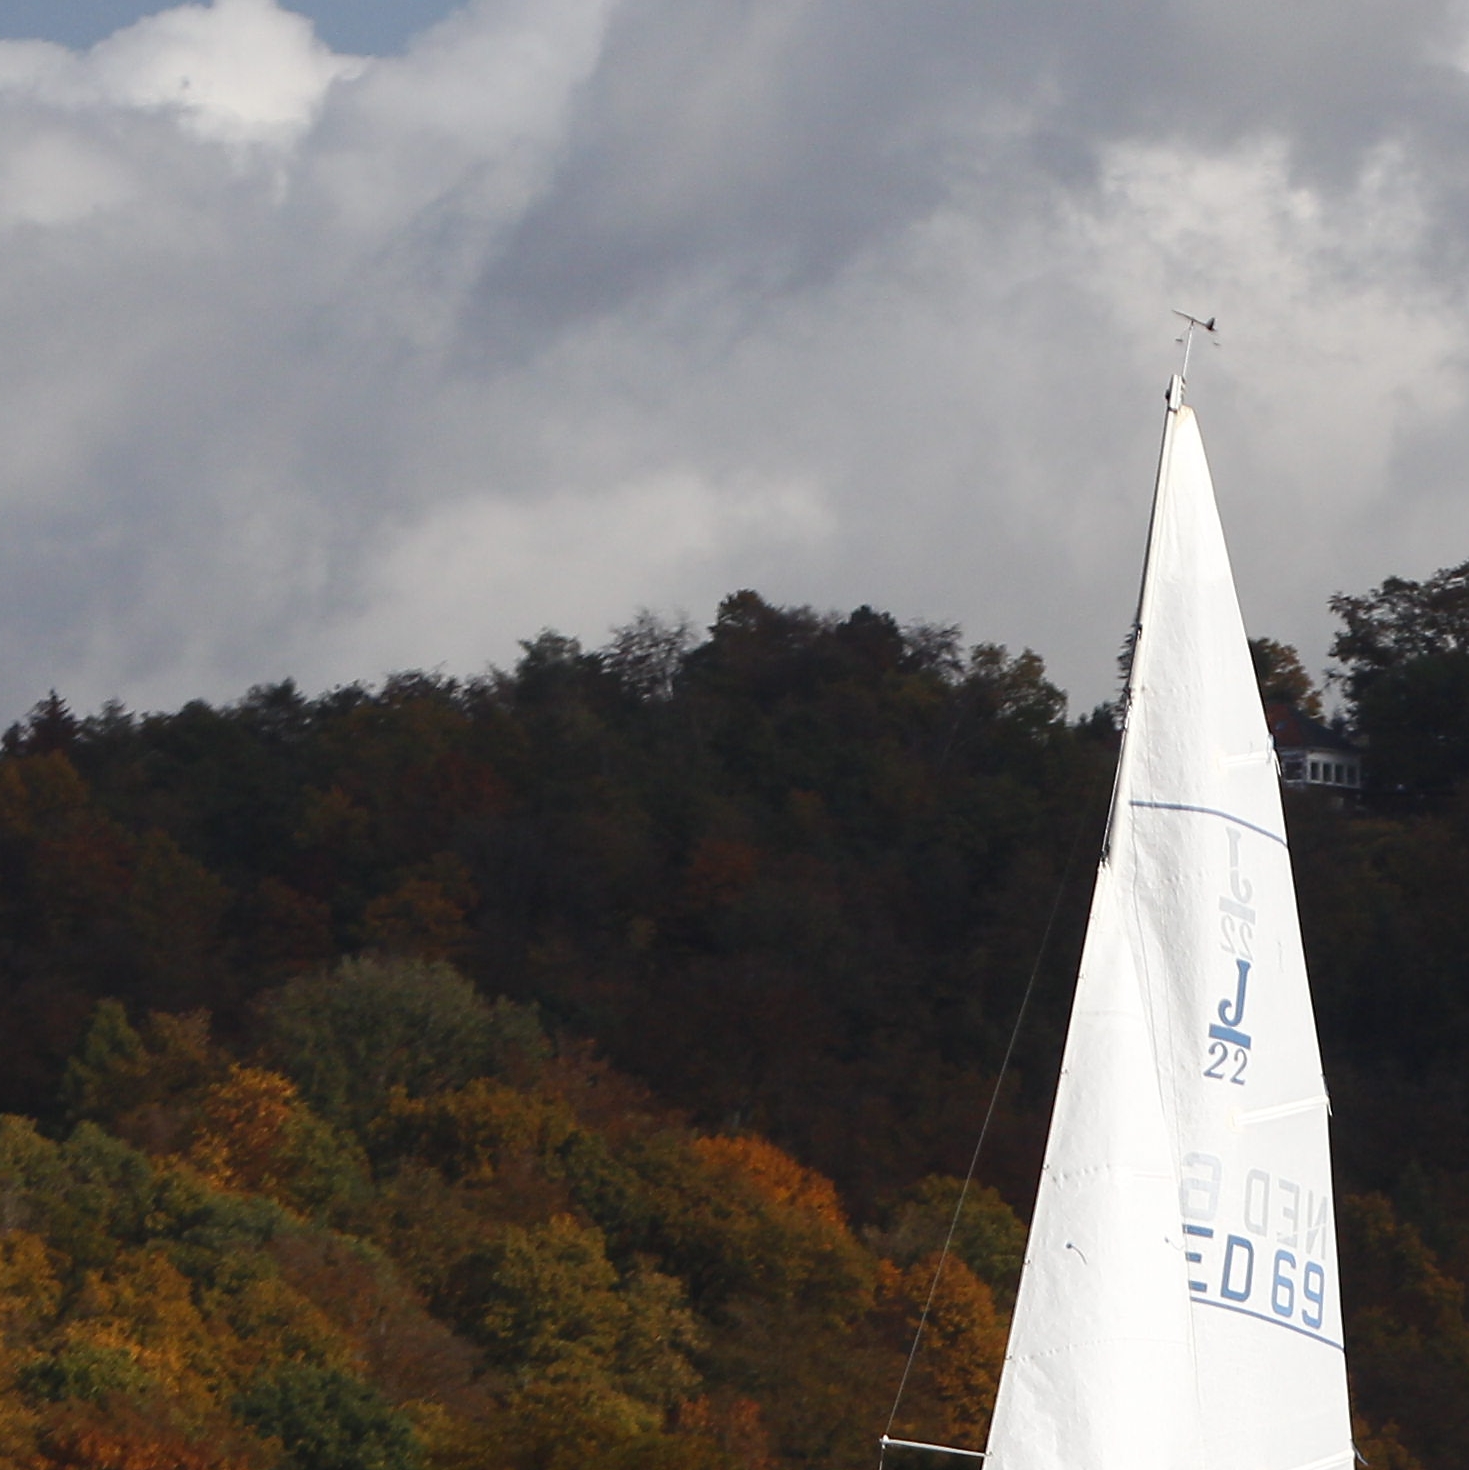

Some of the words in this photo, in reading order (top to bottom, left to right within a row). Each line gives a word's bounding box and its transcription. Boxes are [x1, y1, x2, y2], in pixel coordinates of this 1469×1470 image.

[1217, 959, 1251, 1027] J
[1203, 1041, 1248, 1086] 22
[1182, 1223, 1254, 1303] ED
[1271, 1248, 1325, 1330] 69
